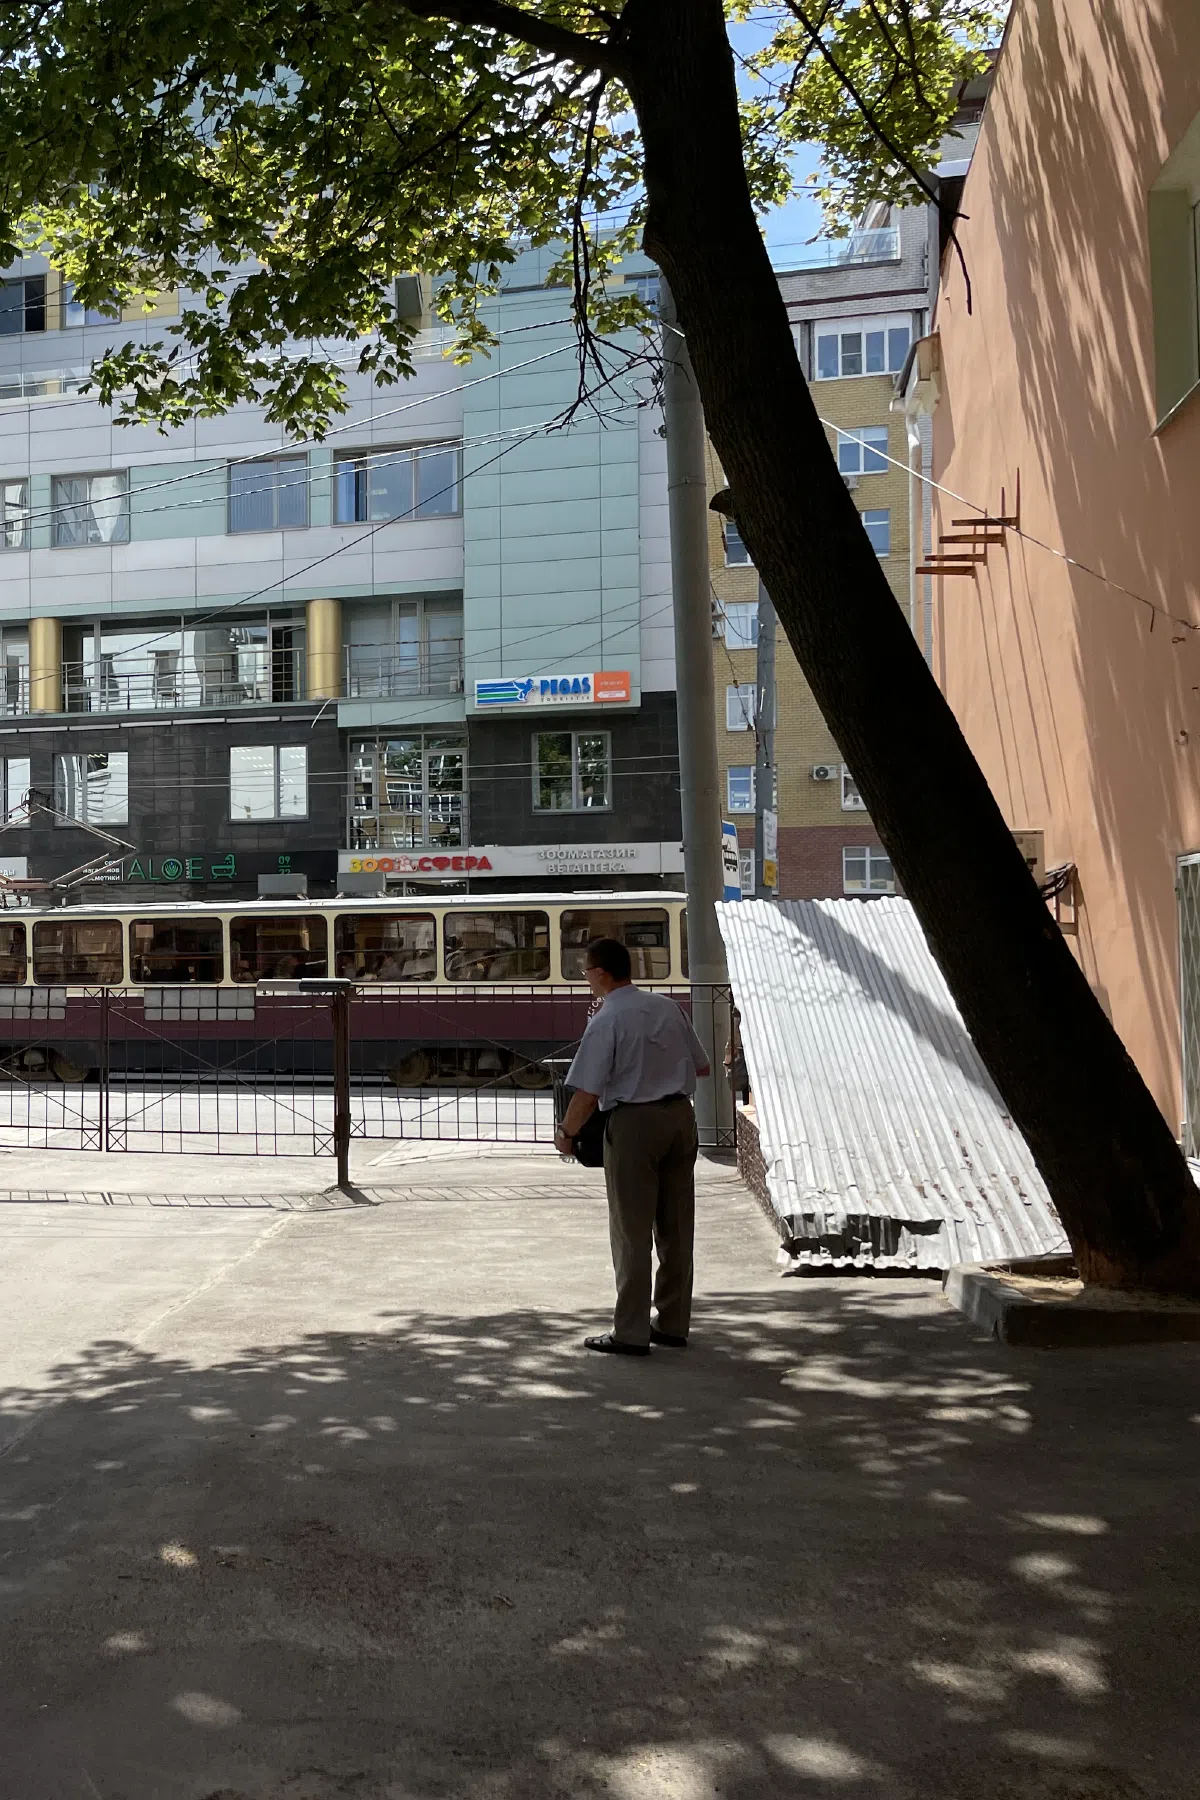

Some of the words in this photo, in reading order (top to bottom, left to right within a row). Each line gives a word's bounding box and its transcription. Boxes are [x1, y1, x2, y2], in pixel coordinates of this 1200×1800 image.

[540, 677, 591, 696] PEGAS
[538, 848, 637, 860] ЗООМАГАЗИН
[278, 855, 291, 865] 09
[547, 862, 627, 873] ВЕТАПТЕКА
